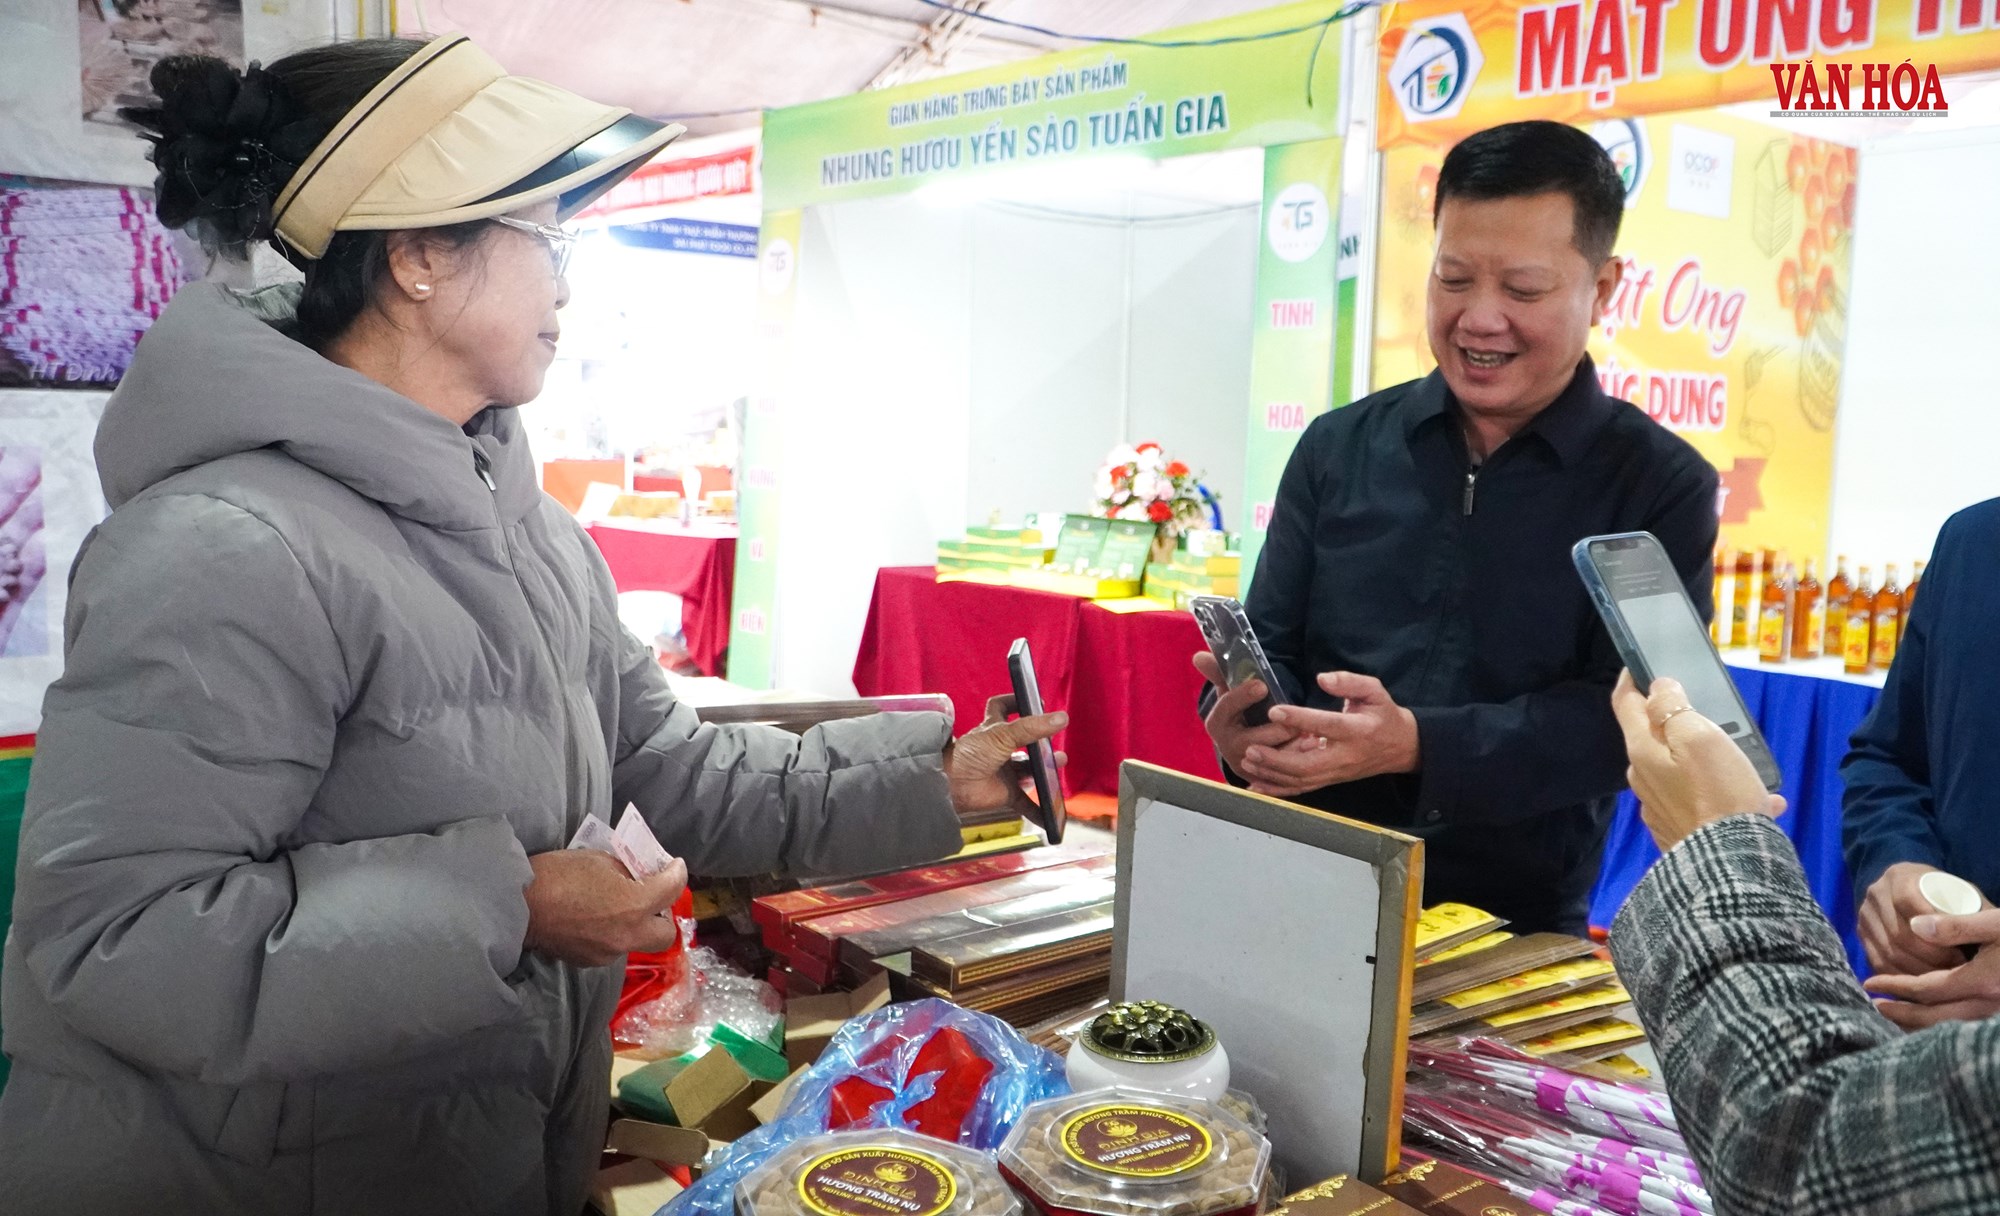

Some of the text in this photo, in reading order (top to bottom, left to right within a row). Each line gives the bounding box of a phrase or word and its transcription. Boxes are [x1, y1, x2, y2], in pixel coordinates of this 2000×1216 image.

[889, 56, 1128, 126] GIAN HÀNG TRƯNG BÀY SẢN PHẨM
[822, 92, 1228, 186] NHUNG HƯƠU YẾN SÀO TUẤN GIA
[1272, 302, 1315, 328] TINH
[1601, 260, 1746, 352] ật Ong
[30, 362, 66, 381] HT
[1268, 404, 1305, 429] HOA
[1649, 376, 1726, 426] DUNG
[1097, 1147, 1142, 1163] HƯƠNG
[817, 1176, 865, 1194] HƯƠNG
[900, 1200, 921, 1212] NỤ
